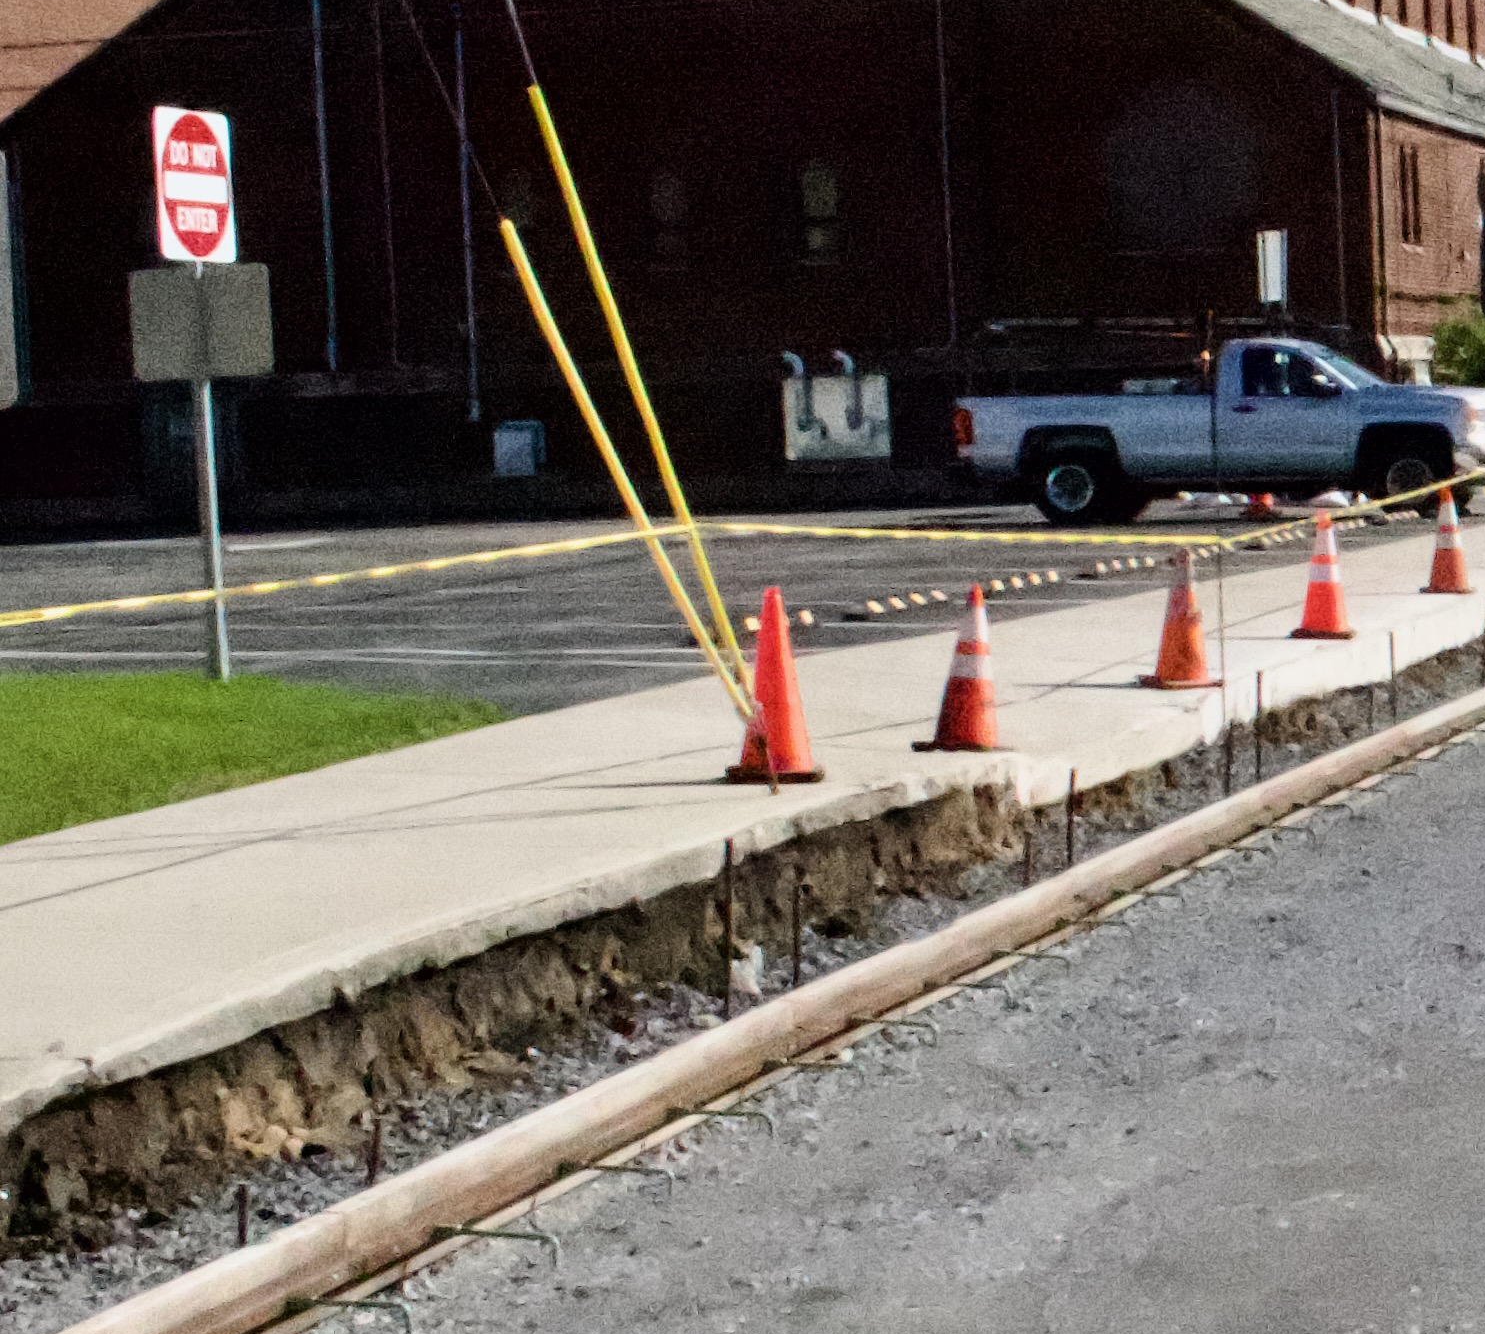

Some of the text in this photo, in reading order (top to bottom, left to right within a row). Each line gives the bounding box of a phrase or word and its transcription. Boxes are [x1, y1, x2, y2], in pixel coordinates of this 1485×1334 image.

[169, 139, 217, 169] DO NOT
[176, 206, 219, 234] ENTER
